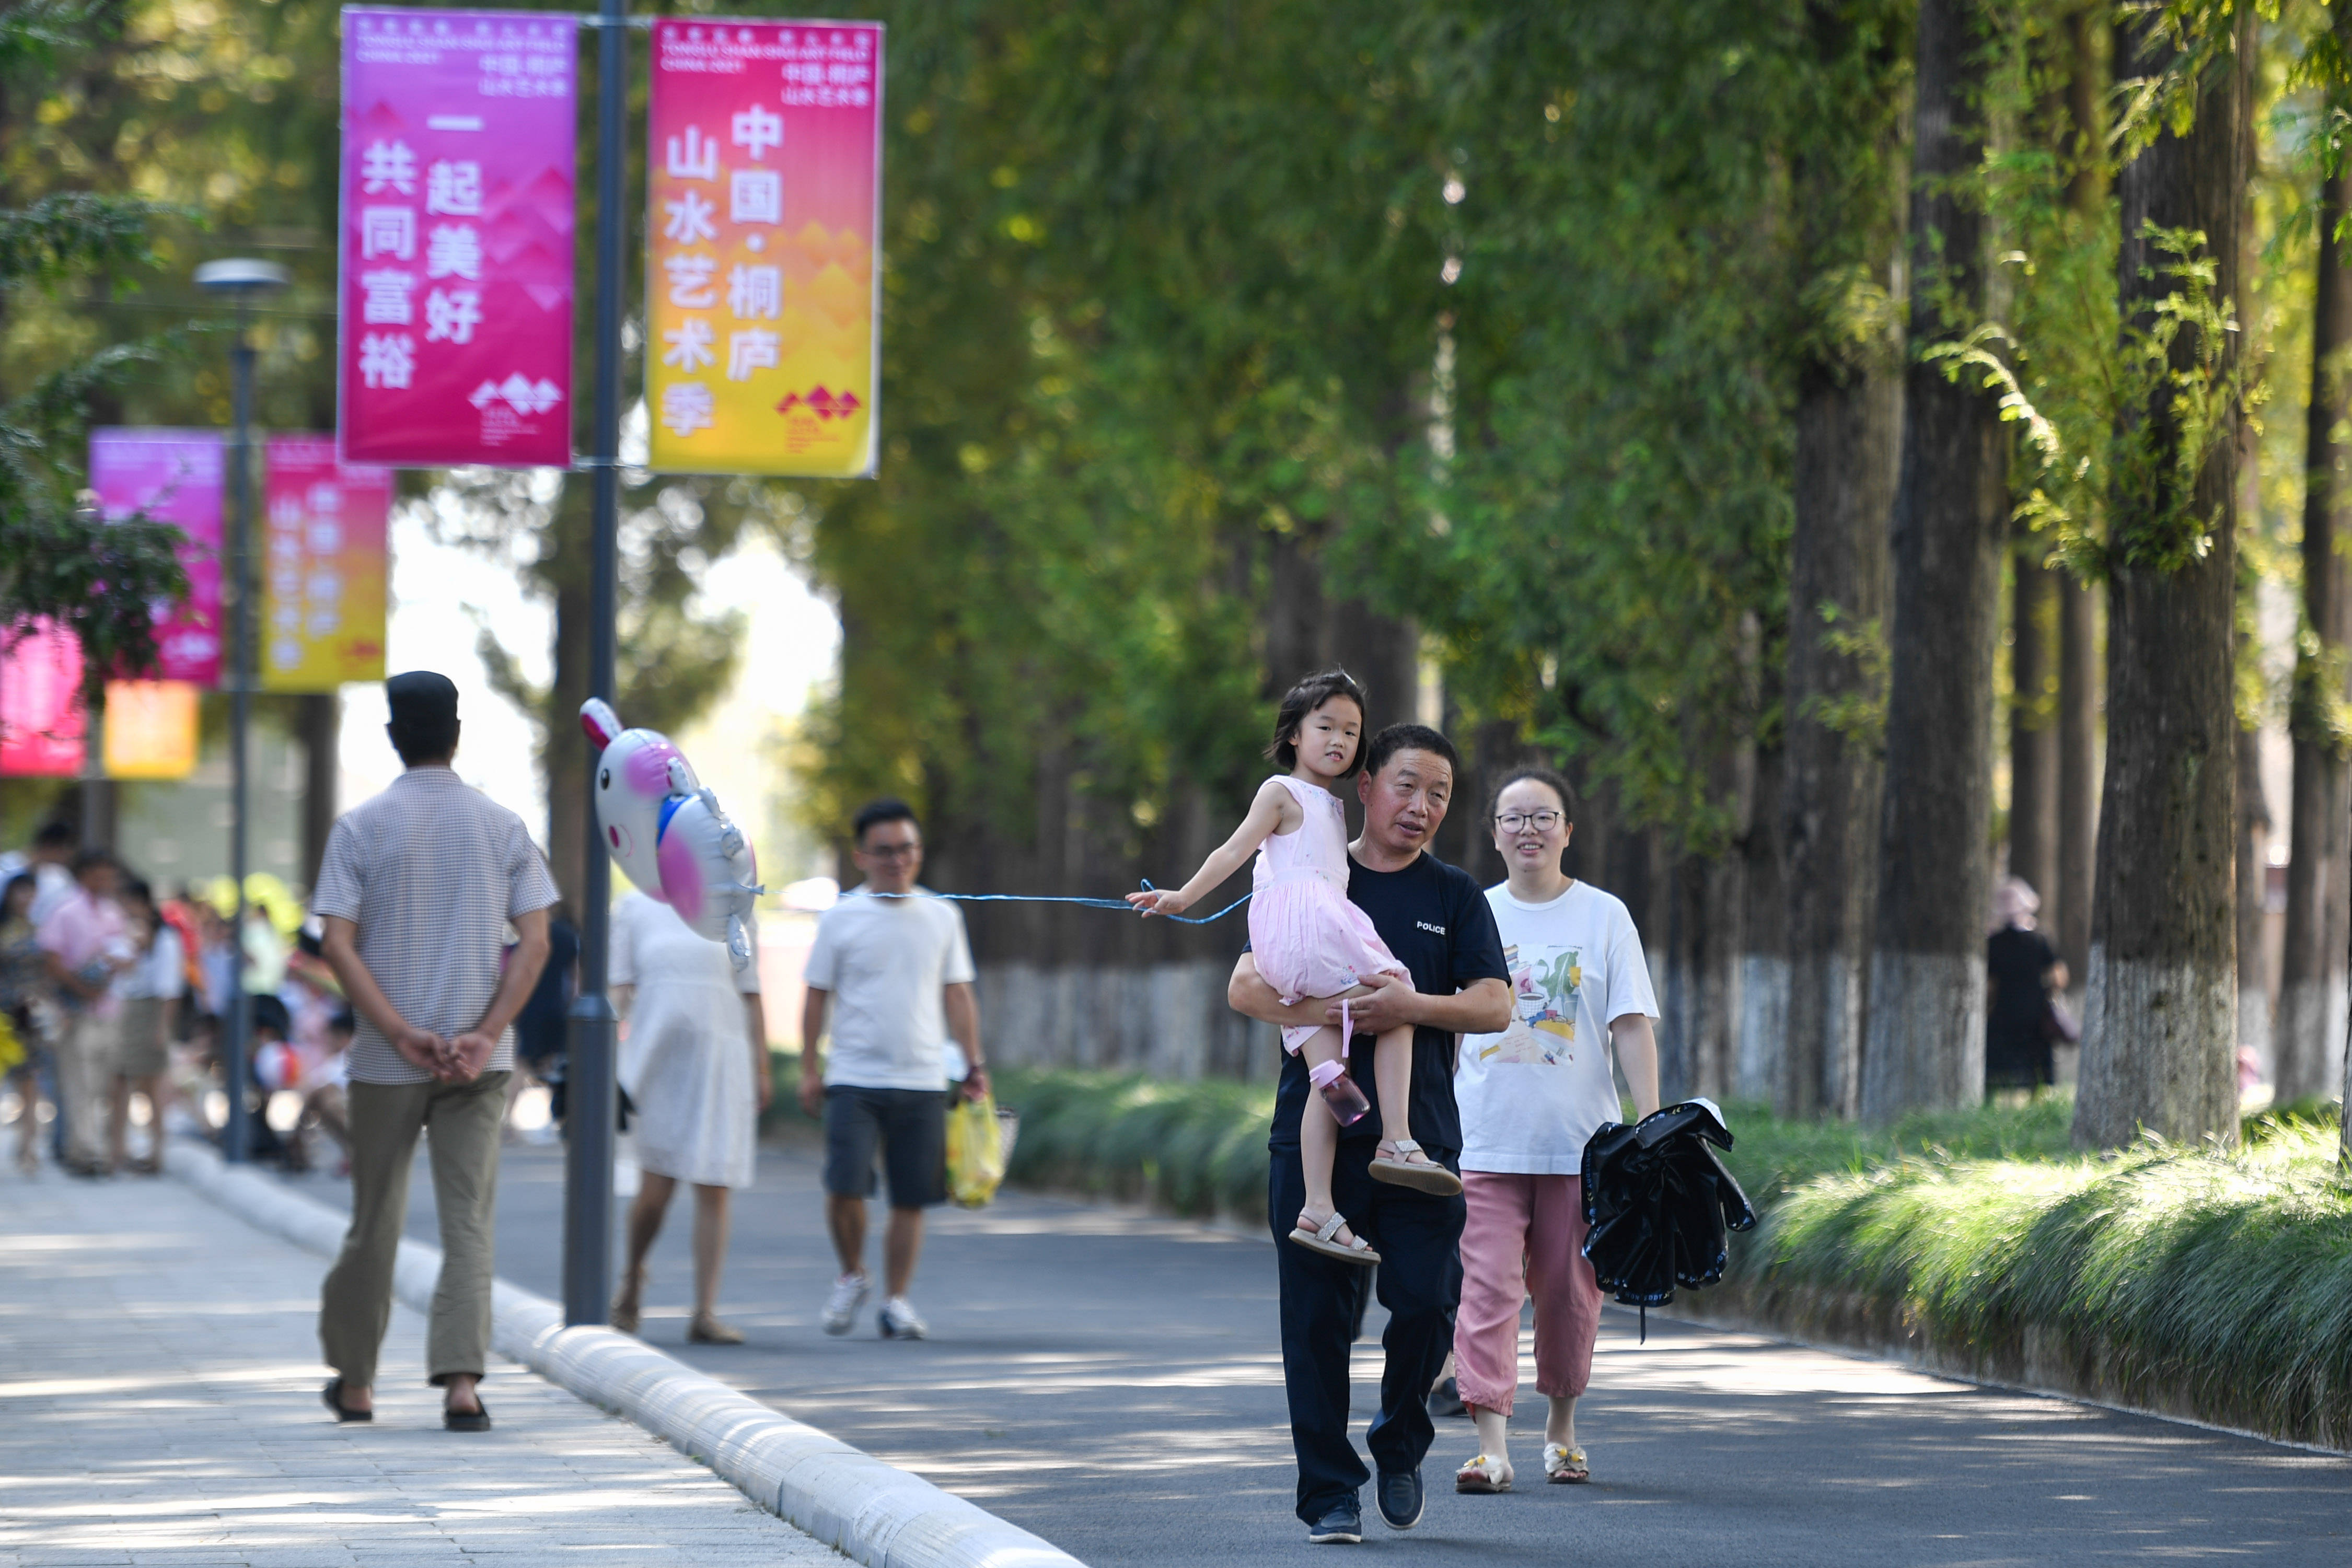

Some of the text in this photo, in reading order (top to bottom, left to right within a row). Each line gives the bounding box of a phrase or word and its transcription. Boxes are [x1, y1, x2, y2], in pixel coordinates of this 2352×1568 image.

[358, 138, 416, 391] 共同富裕
[426, 115, 484, 345] 一起美好
[661, 125, 719, 438] 山水艺术季
[1417, 921, 1445, 935] POLICE
